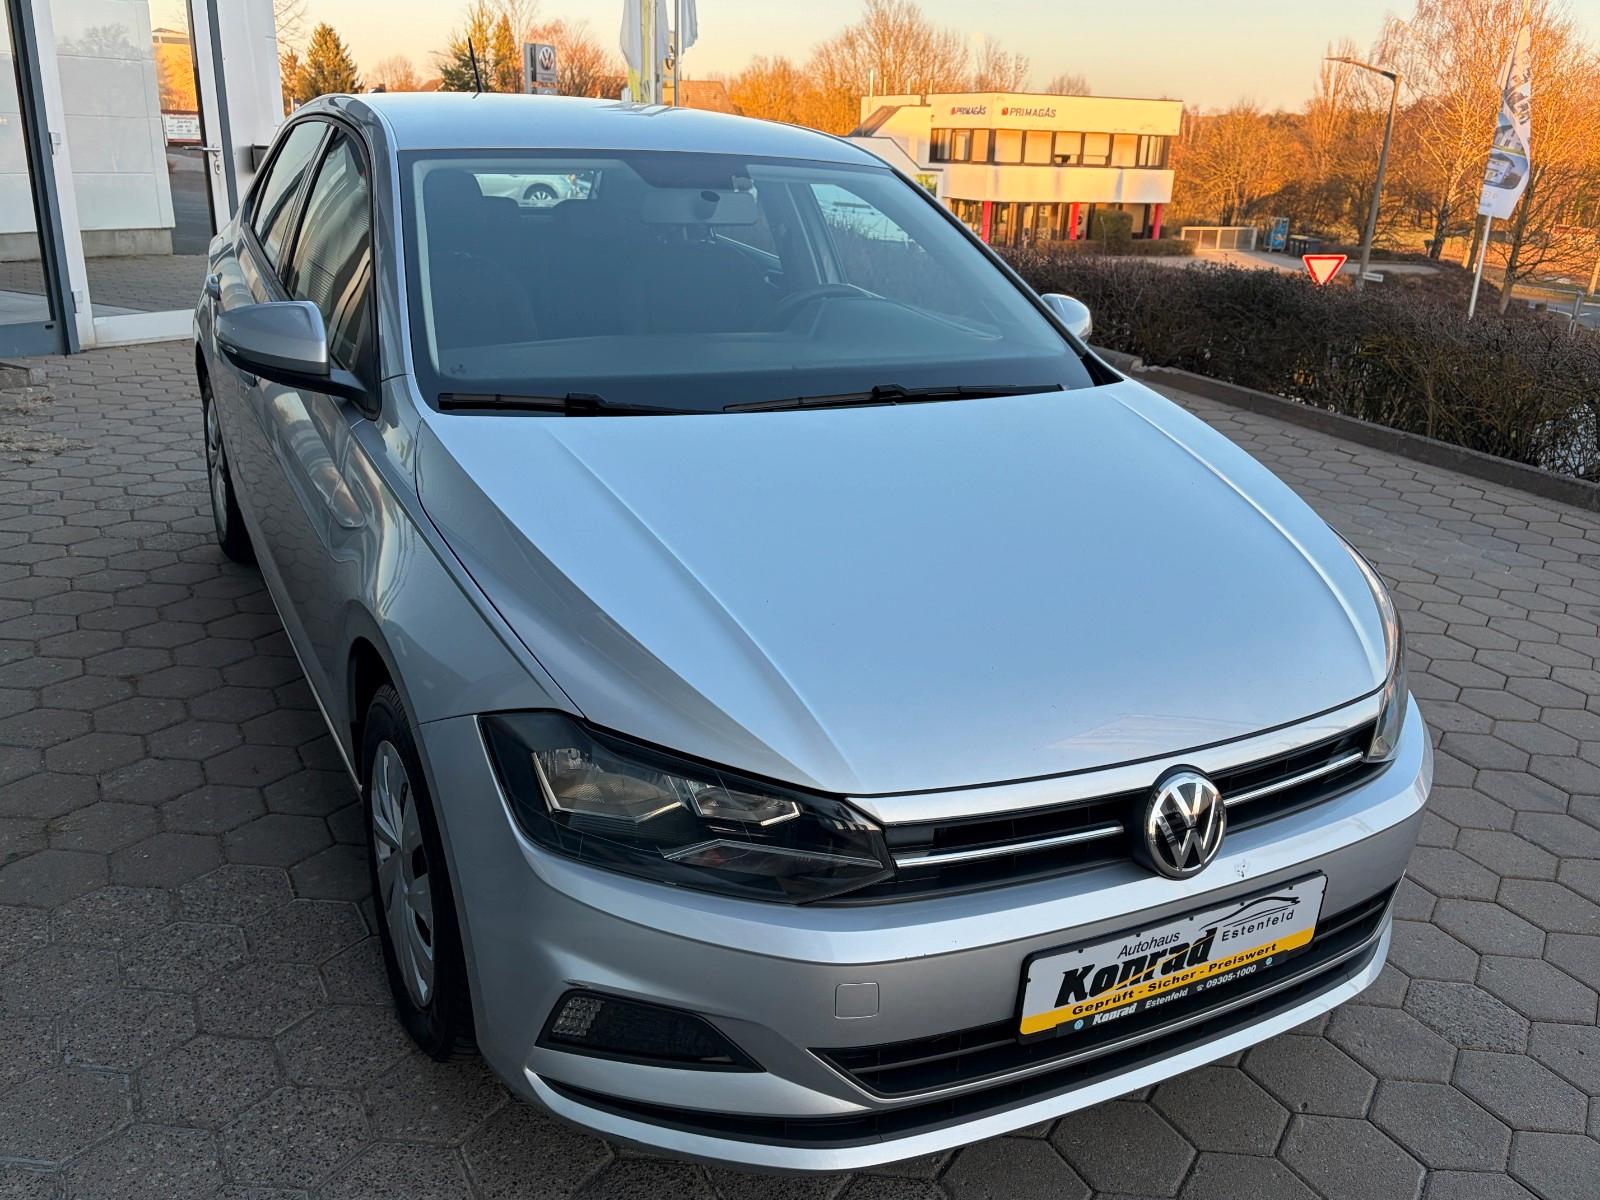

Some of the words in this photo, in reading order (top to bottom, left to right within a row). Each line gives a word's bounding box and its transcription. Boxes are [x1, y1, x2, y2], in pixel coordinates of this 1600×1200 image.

[1009, 107, 1056, 118] PRIMAGAS
[1149, 772, 1224, 875] VW
[1117, 931, 1181, 960] Autohaus
[1220, 908, 1295, 942] Estenfeld
[1053, 926, 1219, 1008] Konrad
[1071, 990, 1134, 1016] Geprüft
[1147, 970, 1196, 993] Sicher
[1208, 942, 1278, 973] Preiswert
[1092, 1003, 1138, 1025] Konrad
[1144, 988, 1189, 1009] Estenfeld
[1206, 964, 1258, 989] 09305-1000
